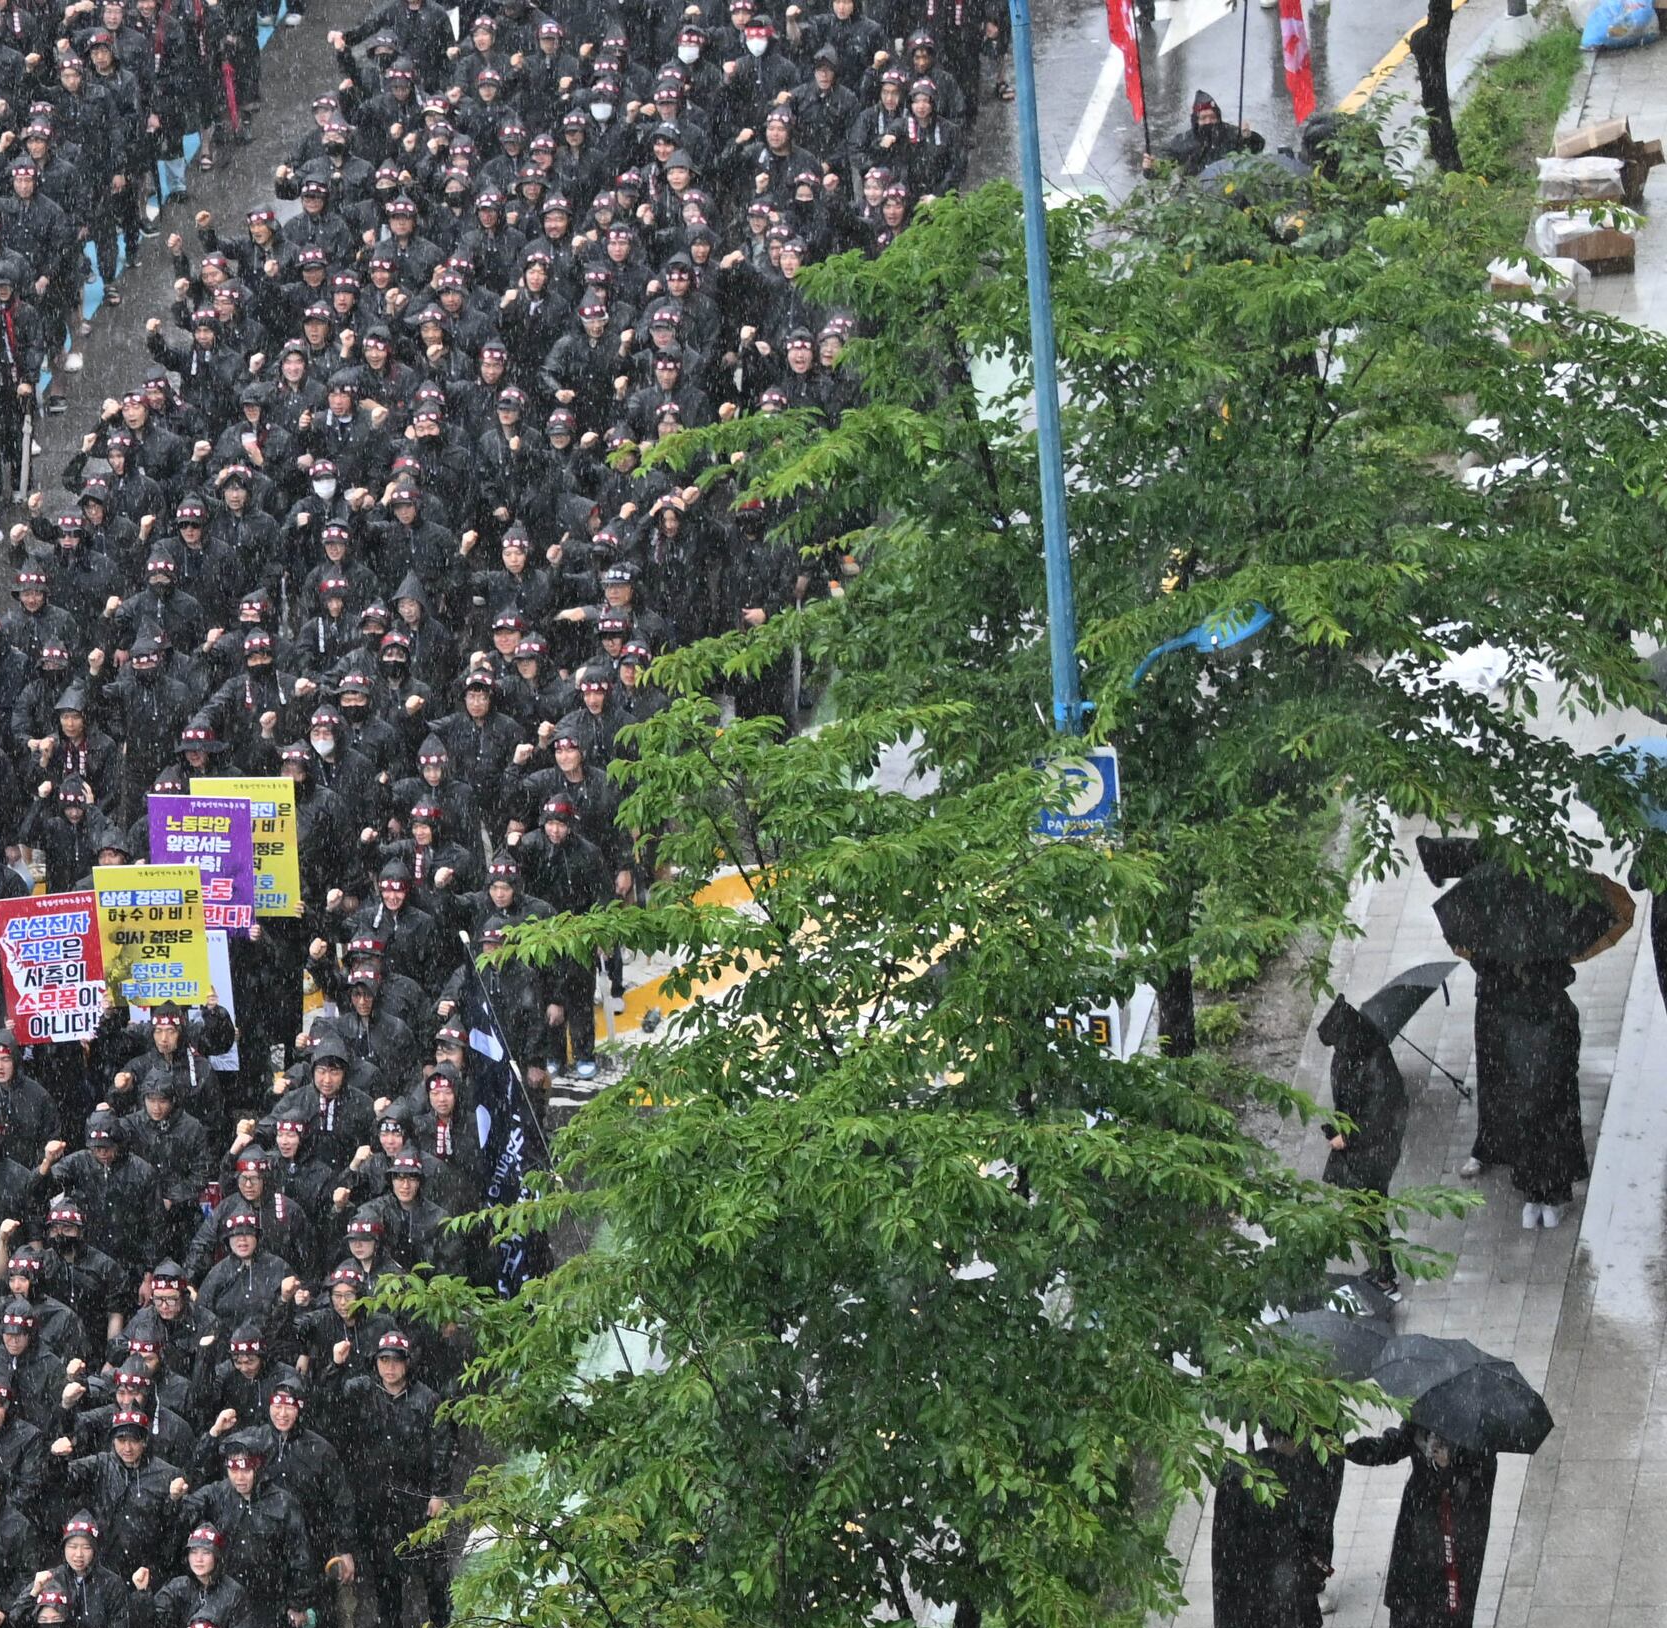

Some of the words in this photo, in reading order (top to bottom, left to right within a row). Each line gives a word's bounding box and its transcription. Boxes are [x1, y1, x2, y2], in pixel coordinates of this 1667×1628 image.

[6, 912, 91, 940] 삼성전자
[20, 938, 82, 961] 직원은
[24, 962, 85, 987] 사측의
[16, 987, 100, 1015] 소모품이
[29, 1013, 99, 1038] 아니다!
